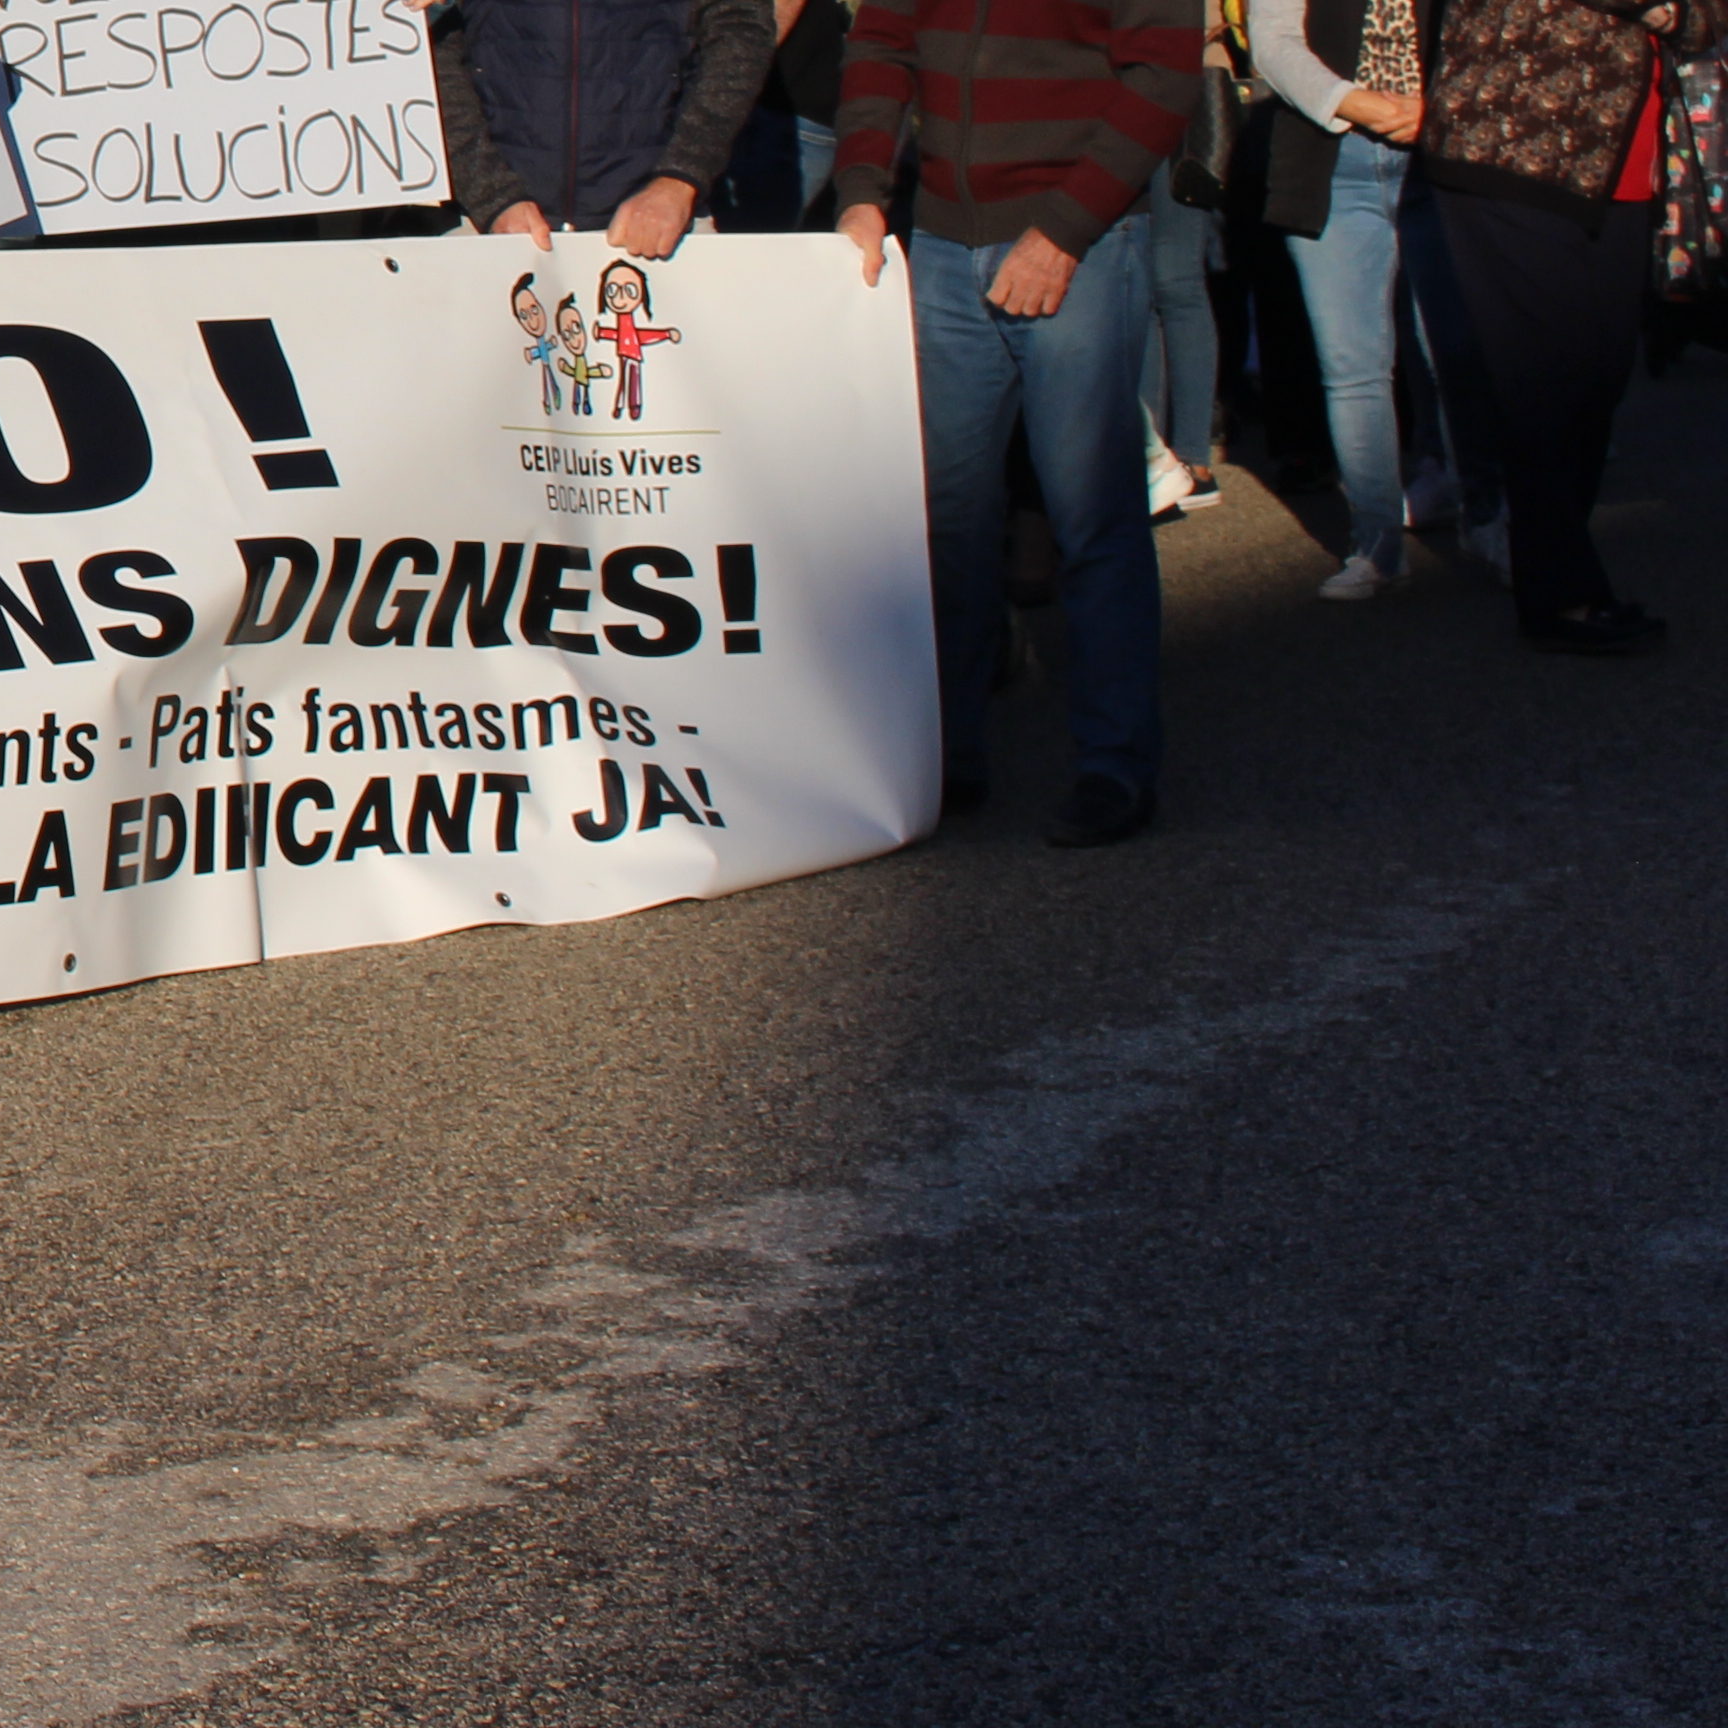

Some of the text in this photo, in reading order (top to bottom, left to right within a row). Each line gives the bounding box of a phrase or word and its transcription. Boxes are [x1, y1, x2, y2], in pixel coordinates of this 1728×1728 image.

[521, 445, 561, 472] CEIP
[620, 450, 701, 475] Vives
[546, 484, 668, 514] BOCAIRENT
[223, 537, 761, 657] DIGNES!
[302, 688, 656, 753] fantasmes
[573, 759, 726, 842] JA!
